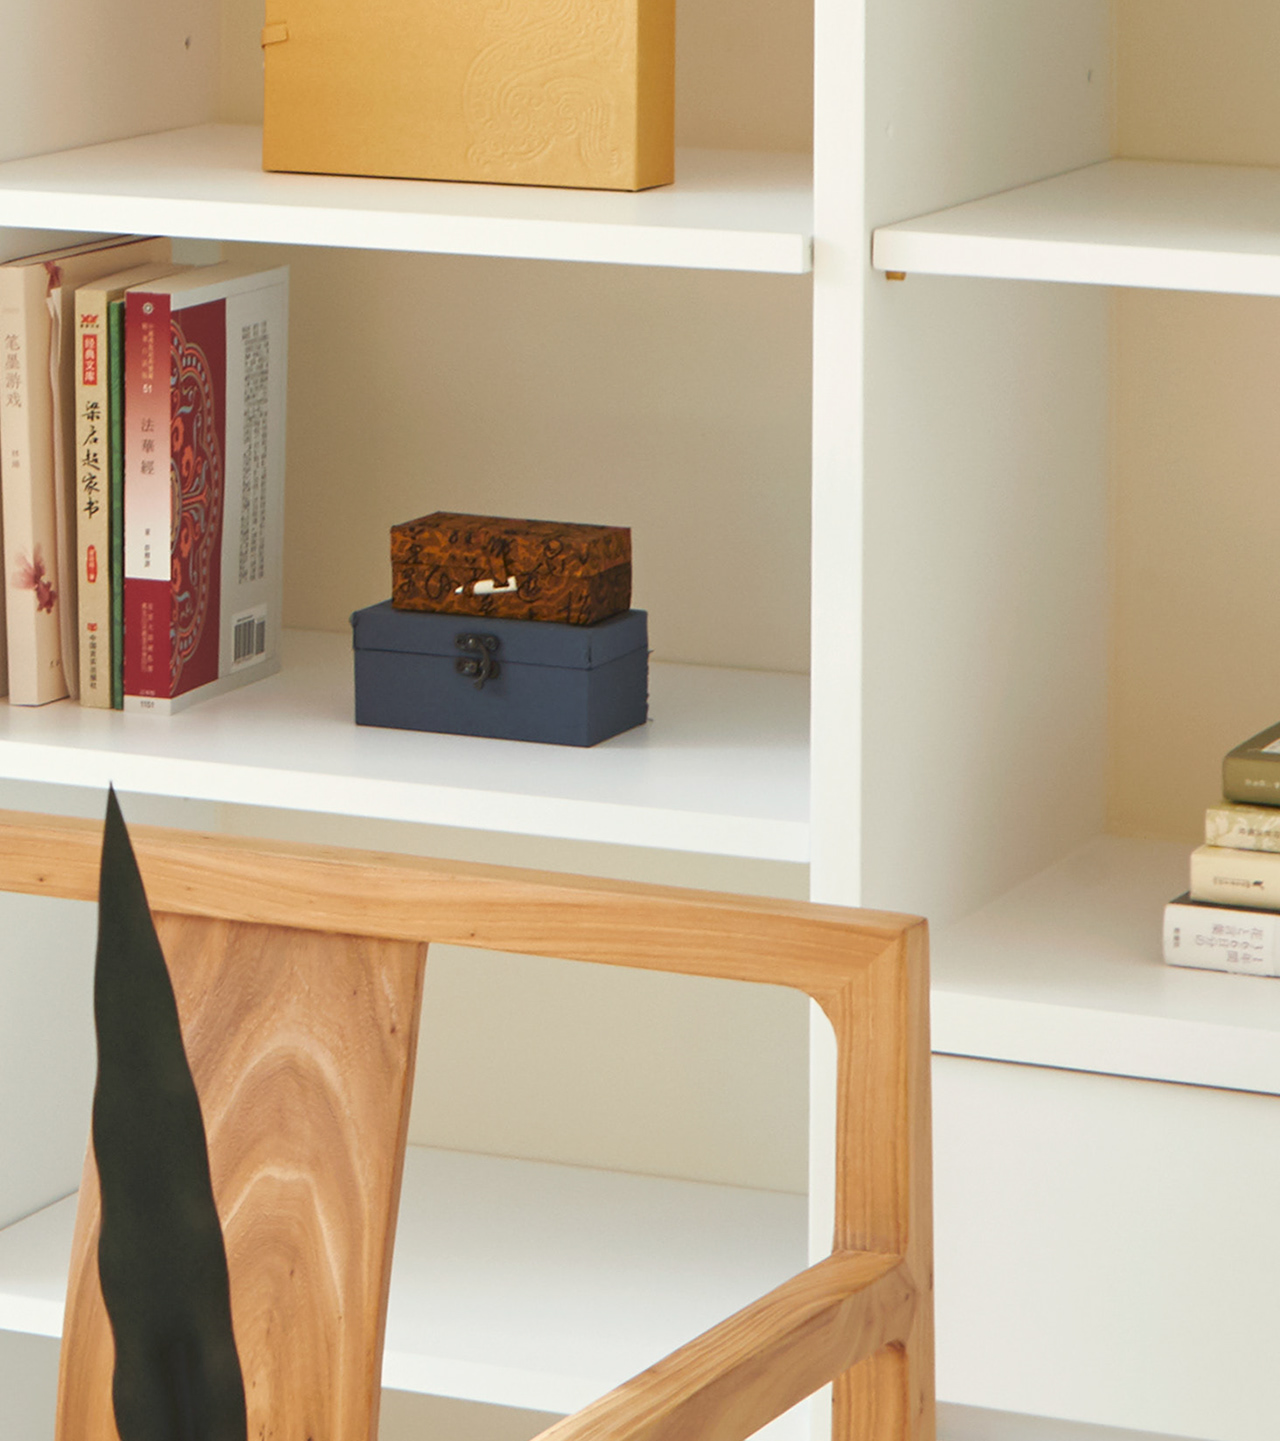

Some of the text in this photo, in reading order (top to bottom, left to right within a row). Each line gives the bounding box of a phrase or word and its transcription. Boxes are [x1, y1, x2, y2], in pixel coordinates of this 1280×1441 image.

[3, 333, 23, 409] 笔墨游戏
[84, 338, 96, 382] 经典文库
[81, 400, 101, 519] 梁启超家书
[141, 418, 155, 475] 法華經
